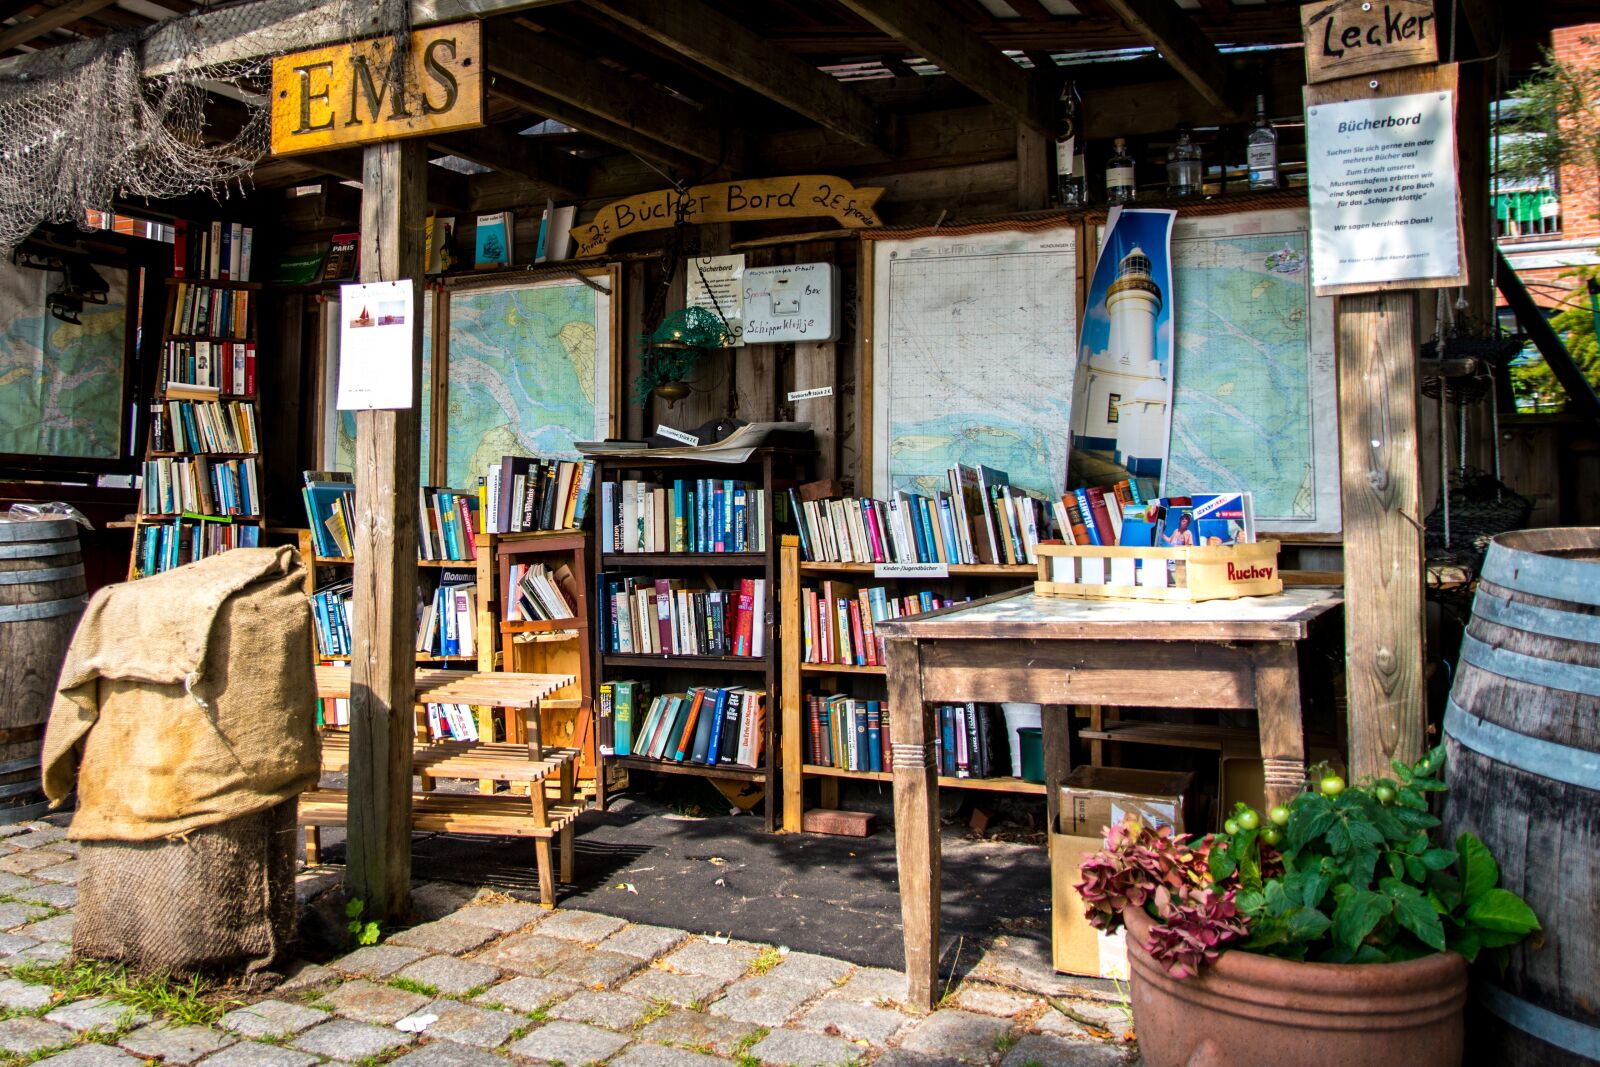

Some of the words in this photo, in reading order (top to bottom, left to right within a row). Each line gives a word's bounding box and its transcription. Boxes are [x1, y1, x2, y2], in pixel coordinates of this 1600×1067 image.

[1323, 5, 1434, 58] Lecker
[291, 37, 458, 136] EMS
[1338, 112, 1422, 133] Bücherbord
[1326, 148, 1352, 157] Suchen
[1353, 146, 1364, 154] Sie
[1365, 144, 1380, 152] sich
[1381, 143, 1402, 152] gerne
[1404, 140, 1415, 148] ein
[1417, 139, 1435, 147] oder
[1343, 156, 1373, 165] mehrere
[1374, 153, 1400, 161] Bücher
[1402, 150, 1419, 158] aus!
[1363, 166, 1385, 174] Erhalt
[1387, 164, 1415, 172] unseres
[1330, 175, 1388, 188] Museumshafens
[1390, 173, 1419, 182] erbitten
[1329, 190, 1344, 198] eine
[1346, 187, 1372, 197] Spende
[1401, 185, 1414, 193] pro
[1416, 182, 1435, 190] Buch
[615, 191, 711, 229] Bücher
[727, 182, 800, 212] Bord
[1337, 200, 1348, 208] für
[843, 199, 874, 227] Spende
[1349, 222, 1370, 230] sagen
[1371, 220, 1408, 228] herzlichen
[1410, 216, 1433, 225] Dank!
[581, 238, 608, 254] Spende
[700, 264, 733, 273] Bücherbord
[805, 284, 821, 296] Box
[524, 488, 536, 511] Wildnis
[523, 510, 532, 527] Evas
[1077, 495, 1095, 528] ATLANTIS
[1227, 561, 1273, 581] Ruchey
